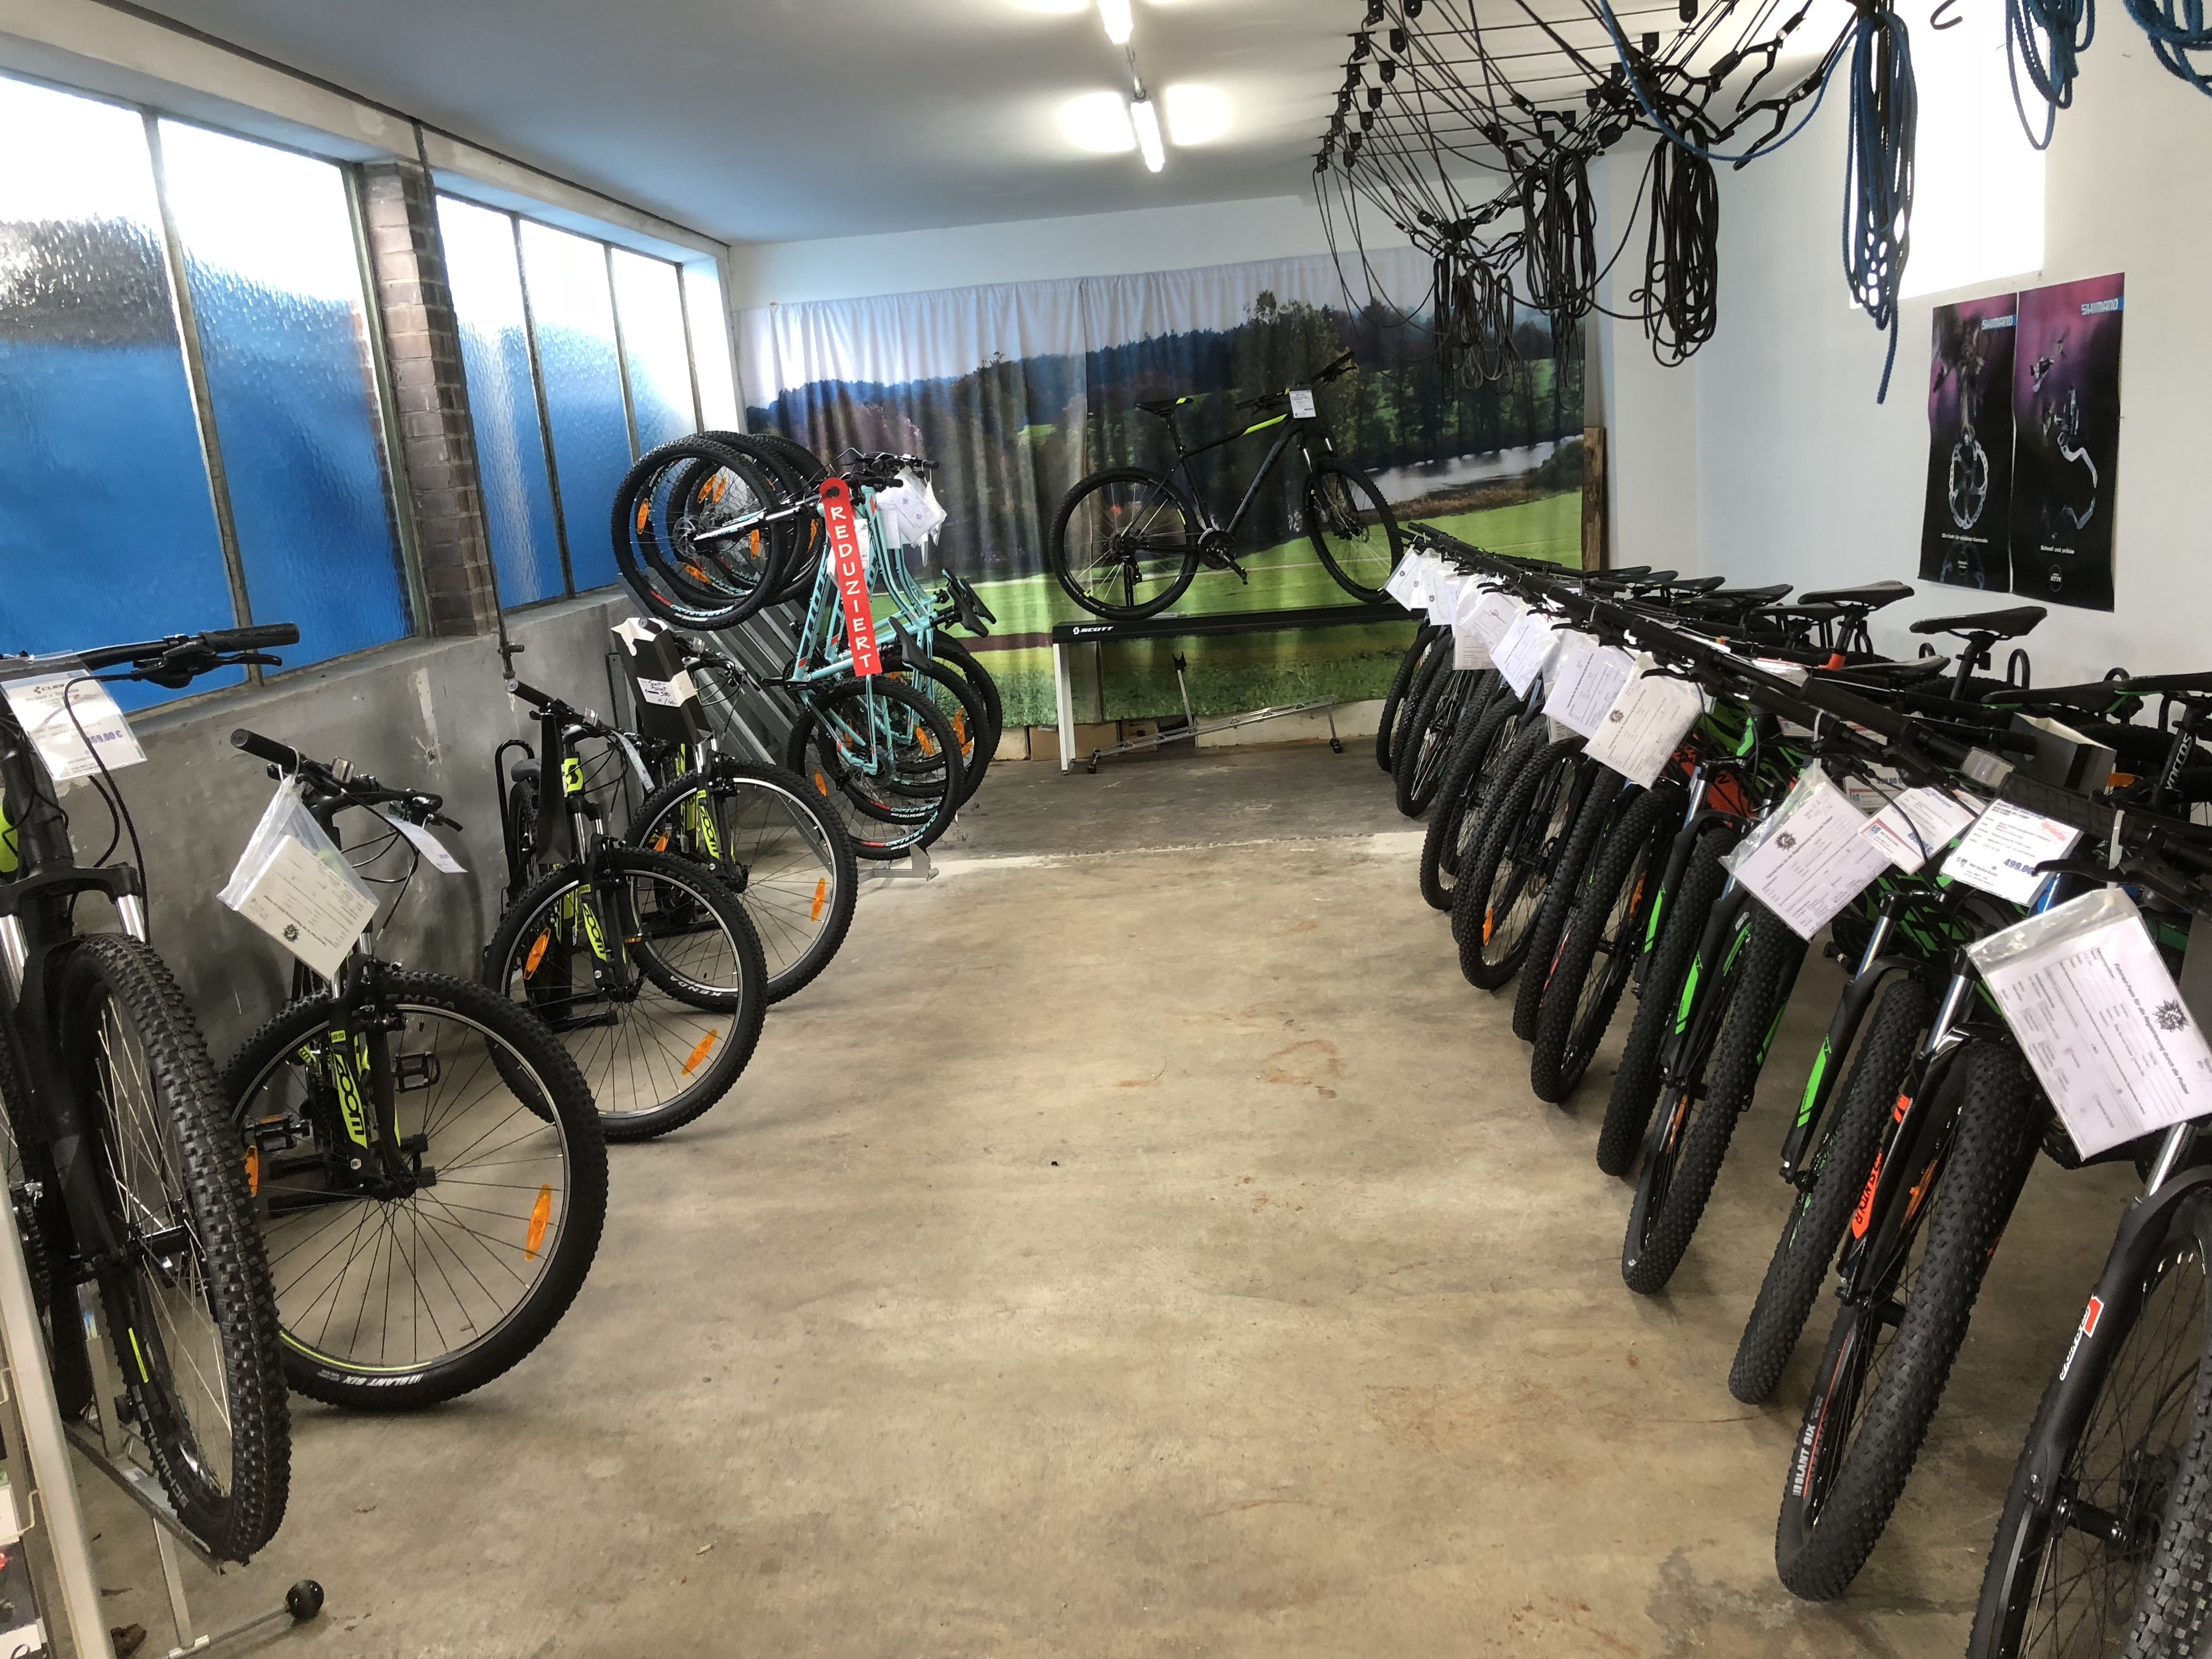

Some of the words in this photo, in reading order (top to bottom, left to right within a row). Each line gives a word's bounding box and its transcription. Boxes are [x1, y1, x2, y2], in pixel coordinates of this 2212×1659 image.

[2080, 298, 2119, 315] SHIMANO
[1982, 315, 2013, 329] SHIMANO
[830, 506, 871, 668] REDUZIERT
[87, 731, 116, 744] 69,00
[669, 975, 722, 996] KENDA
[2132, 997, 2142, 1008] für
[1792, 1447, 1812, 1485] SLANT
[1802, 1423, 1816, 1446] SIX
